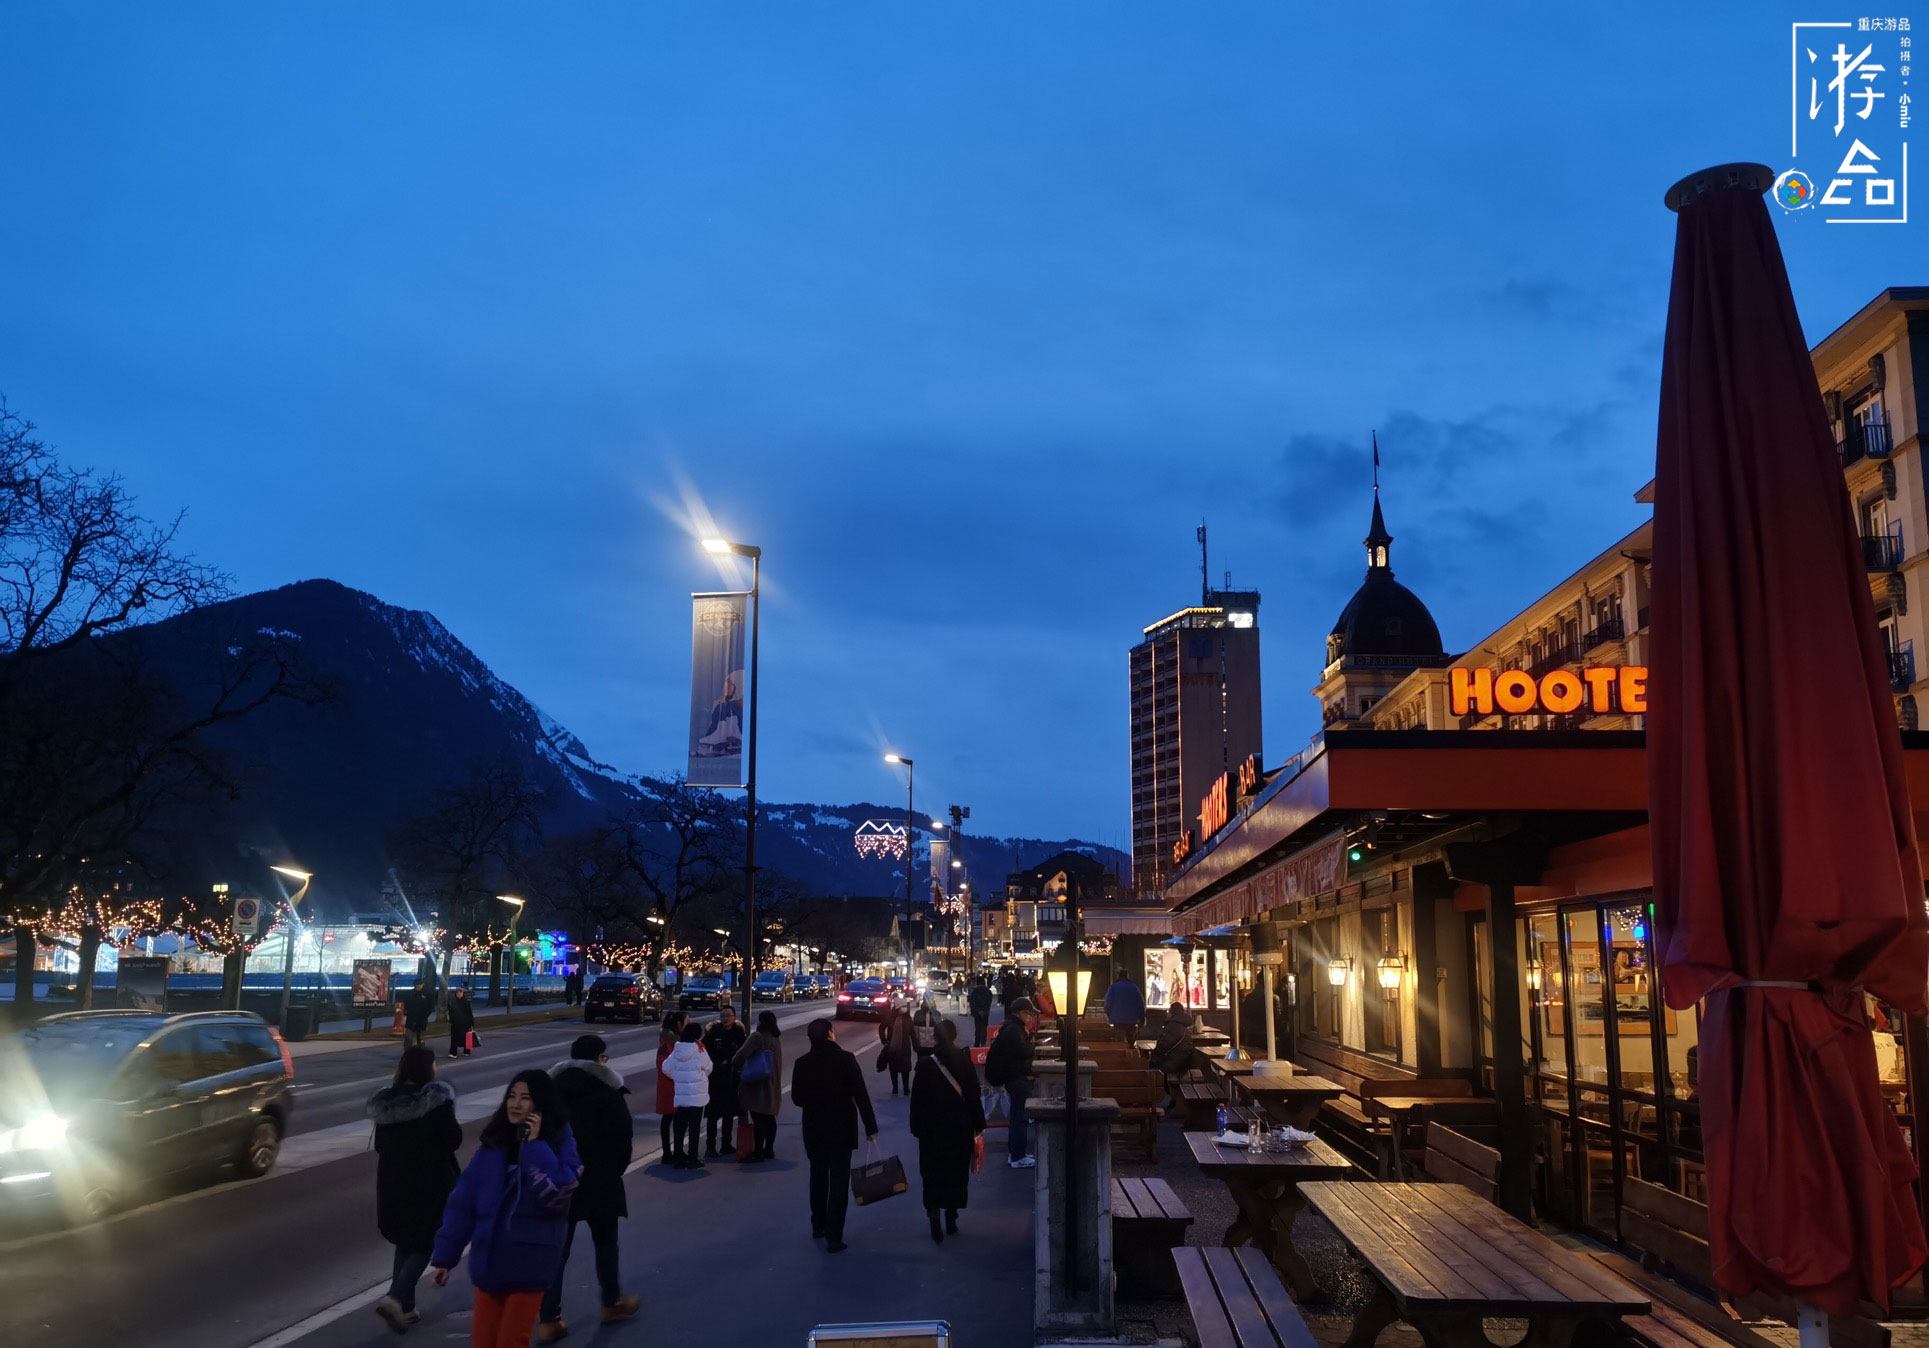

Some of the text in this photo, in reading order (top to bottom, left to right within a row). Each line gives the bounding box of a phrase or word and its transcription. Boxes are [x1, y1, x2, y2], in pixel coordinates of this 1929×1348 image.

[714, 612, 737, 620] MAGIC
[1451, 665, 1649, 715] HOOTE
[1201, 753, 1257, 842] HOOTERS BAR
